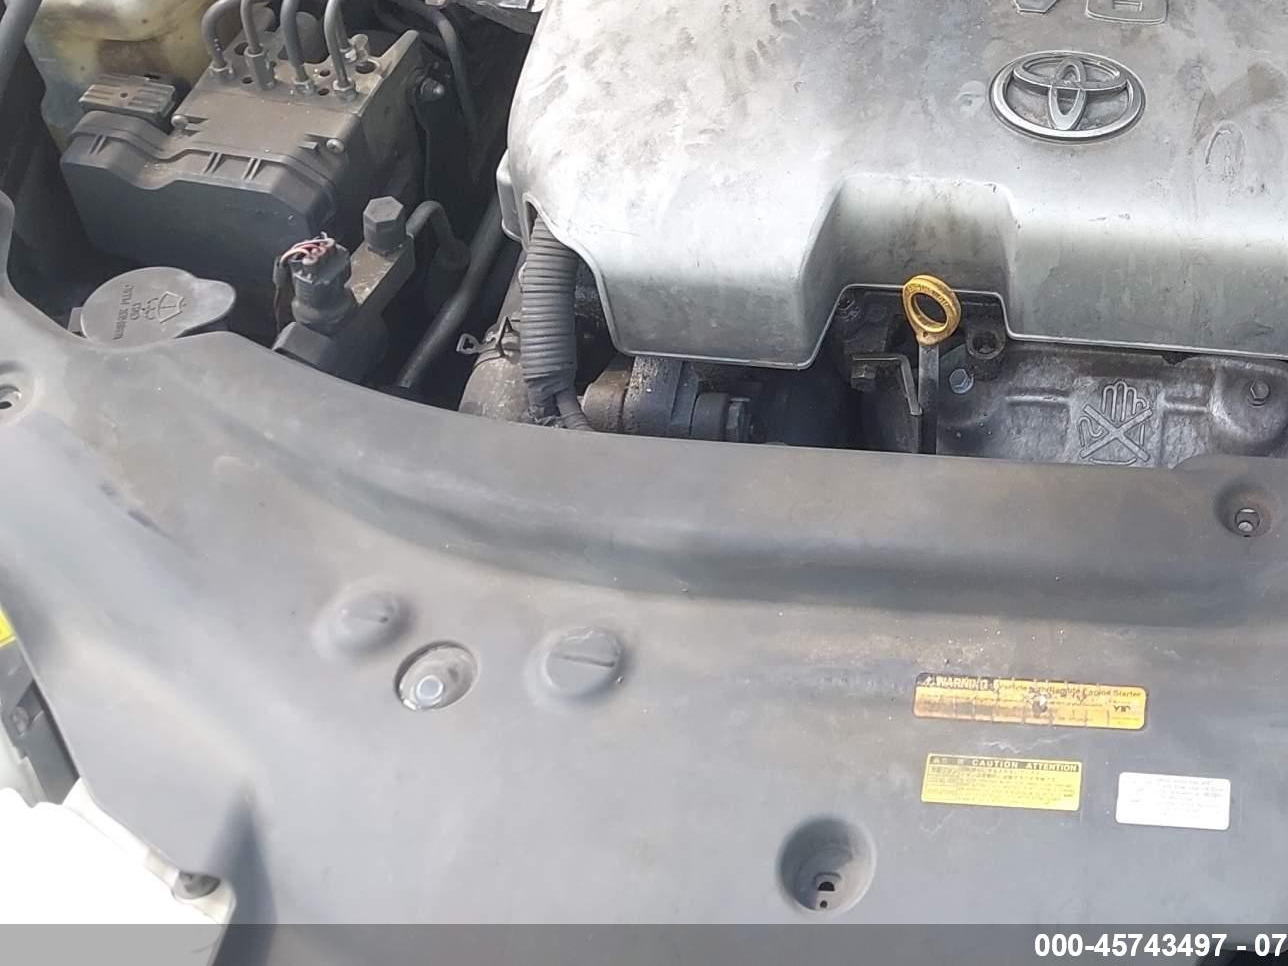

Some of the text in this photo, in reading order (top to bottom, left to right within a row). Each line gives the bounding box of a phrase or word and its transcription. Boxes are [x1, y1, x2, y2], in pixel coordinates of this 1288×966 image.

[936, 676, 989, 691] WARNING
[972, 759, 1018, 768] CAUTION
[1027, 762, 1078, 772] ATTENTION
